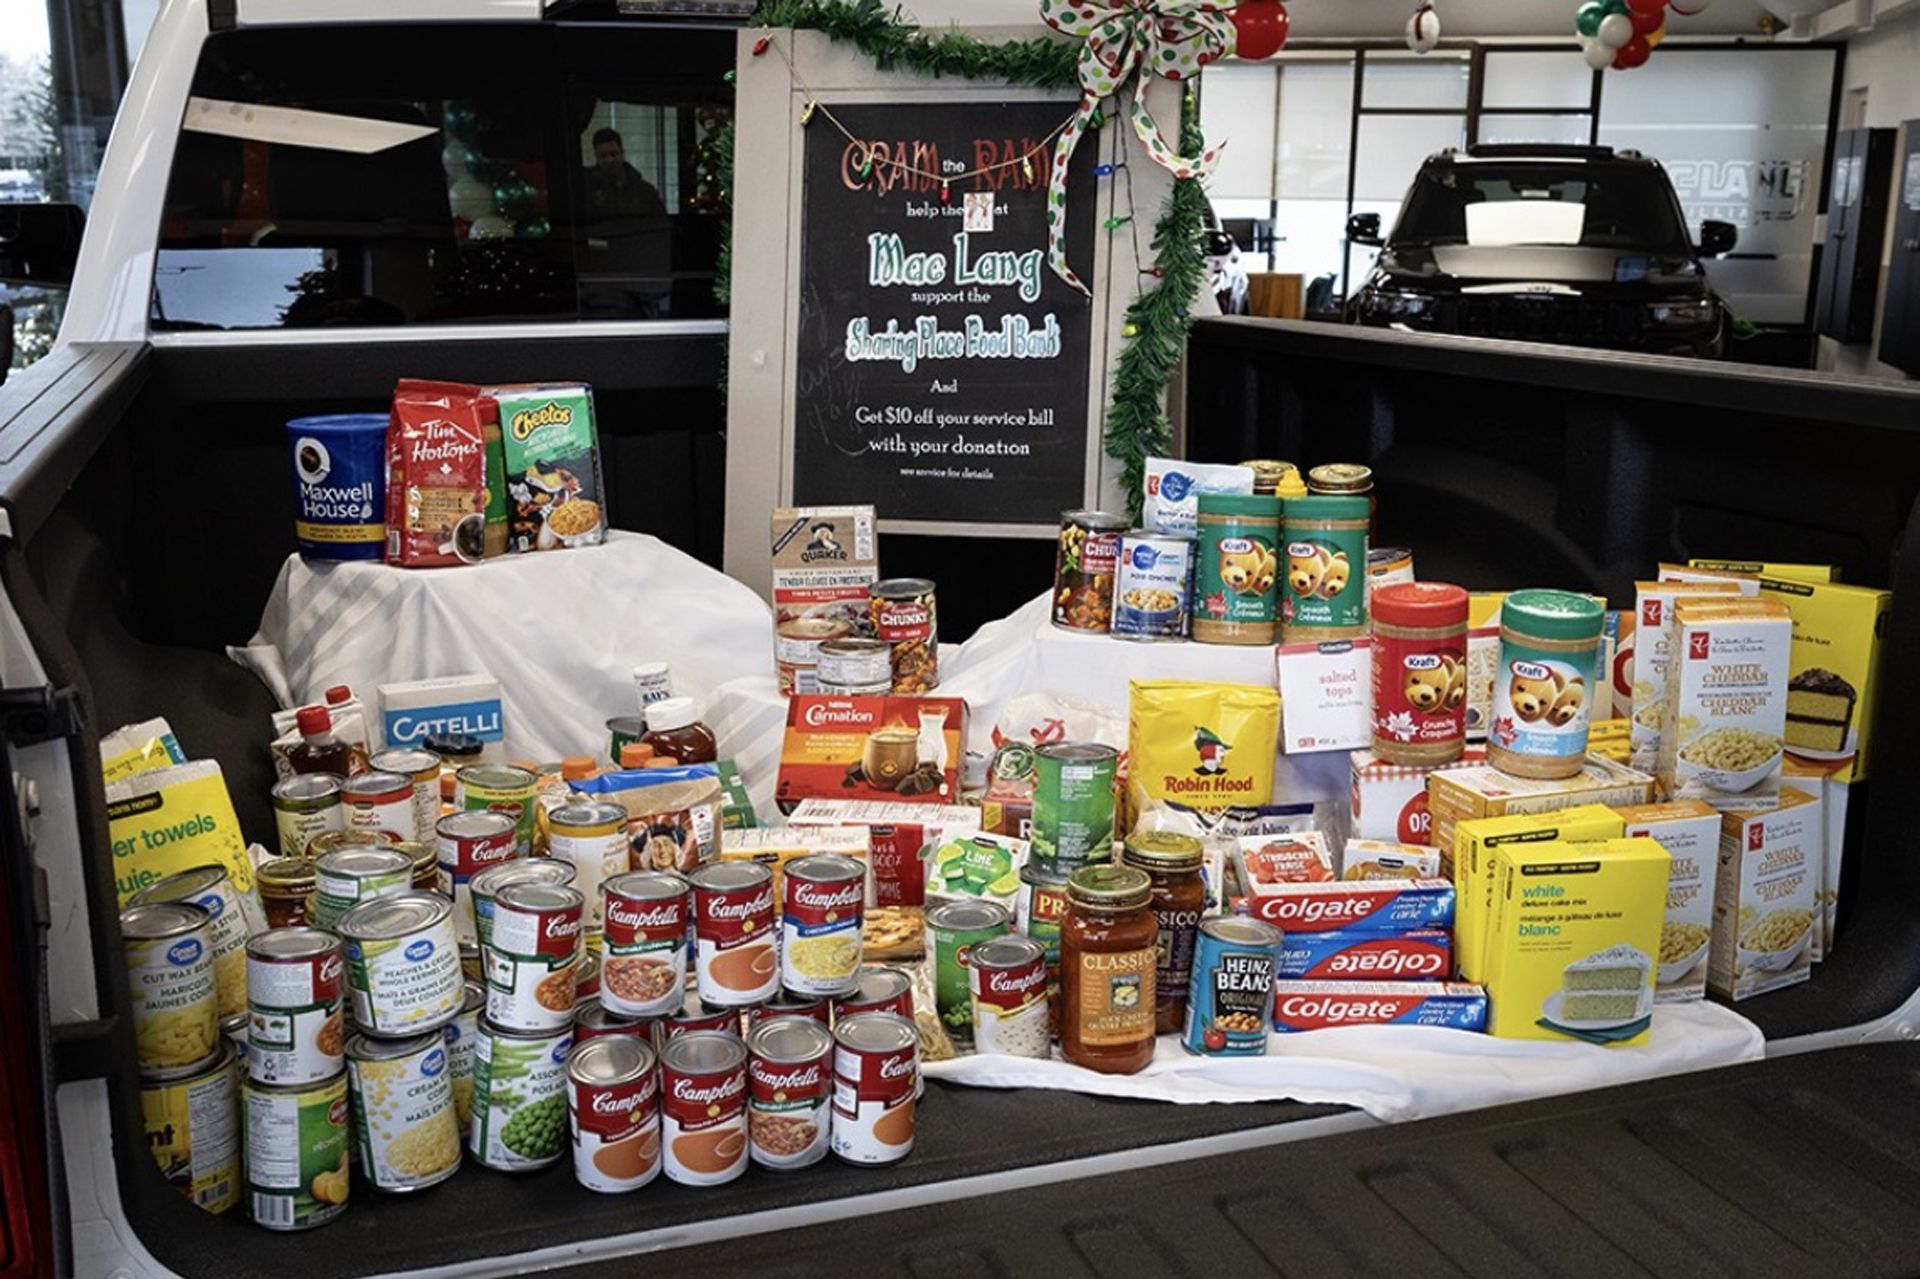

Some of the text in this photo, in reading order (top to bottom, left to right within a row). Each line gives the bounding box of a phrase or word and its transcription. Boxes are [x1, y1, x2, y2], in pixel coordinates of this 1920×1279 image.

[840, 137, 940, 196] CRAM
[943, 159, 966, 173] the
[973, 136, 1052, 192] RAM
[906, 202, 939, 219] help
[940, 203, 963, 216] the
[868, 231, 1044, 303] Mac Lang
[911, 289, 991, 304] support the
[845, 313, 1061, 373] Sharing Place Food Bank
[930, 379, 958, 393] And
[512, 402, 573, 441] Cheetos
[855, 407, 1054, 431] Get $10 off your service bill
[421, 419, 456, 440] Tim
[412, 442, 479, 463] Hortons
[869, 436, 1030, 457] with your donation
[915, 467, 946, 477] service
[948, 467, 961, 478] for
[962, 467, 994, 480] details
[300, 483, 373, 502] Maxwell
[304, 501, 360, 518] House
[1223, 541, 1247, 551] Kraft
[1291, 546, 1310, 555] Kraft
[800, 549, 848, 563] QUAKER
[880, 613, 927, 626] CHUNKY
[1408, 657, 1437, 667] Kraft
[1711, 664, 1761, 673] WHITE
[1319, 670, 1357, 685] salted
[1517, 664, 1543, 677] Kraft
[1702, 673, 1768, 683] CHEDDAR
[1326, 687, 1353, 697] tops
[1701, 697, 1767, 708] CHEDDAR
[805, 704, 873, 726] Carnation
[1710, 706, 1756, 716] BLANC
[392, 712, 498, 741] CATELLI
[1164, 776, 1254, 794] Robin Hood
[141, 814, 216, 849] towels
[966, 851, 994, 865] LIME
[1523, 885, 1564, 897] white
[1261, 897, 1372, 922] Colgate
[1519, 924, 1561, 936] blanc
[1227, 958, 1270, 974] HEINZ
[1331, 953, 1442, 975] Colgate
[1218, 973, 1270, 992] BEANS
[1282, 997, 1398, 1021] Colgate
